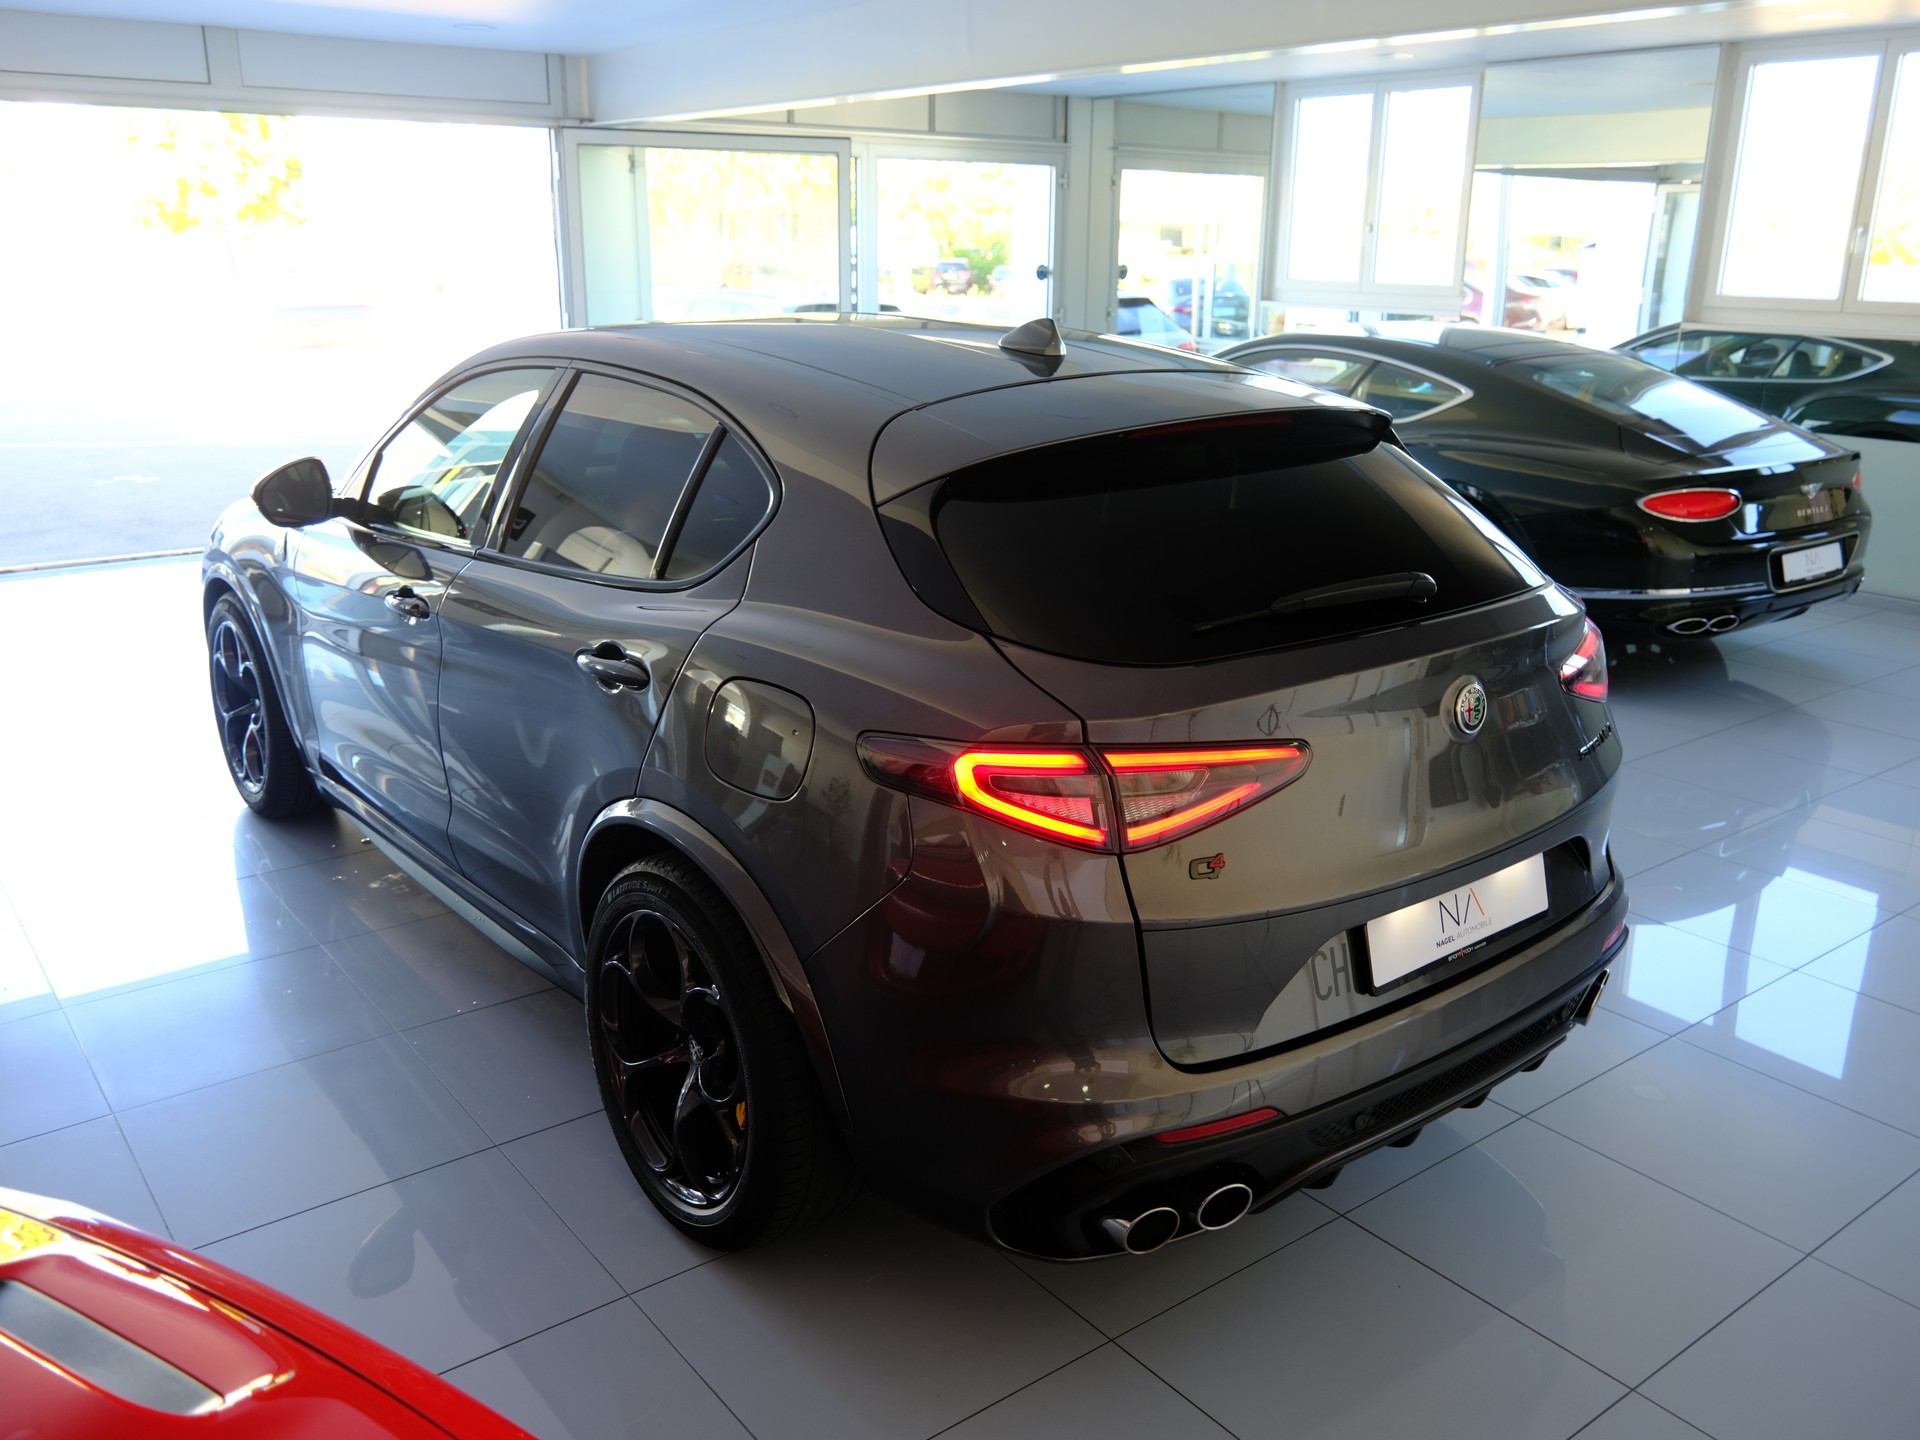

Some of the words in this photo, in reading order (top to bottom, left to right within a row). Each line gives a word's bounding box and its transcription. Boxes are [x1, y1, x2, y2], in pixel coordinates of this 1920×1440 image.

[1189, 852, 1225, 880] Q4
[612, 880, 641, 898] LATITUDE
[642, 880, 662, 895] Sport
[1436, 935, 1456, 949] NAGEL
[1457, 918, 1492, 938] AUTOMOBILE
[1311, 943, 1351, 1001] CH
